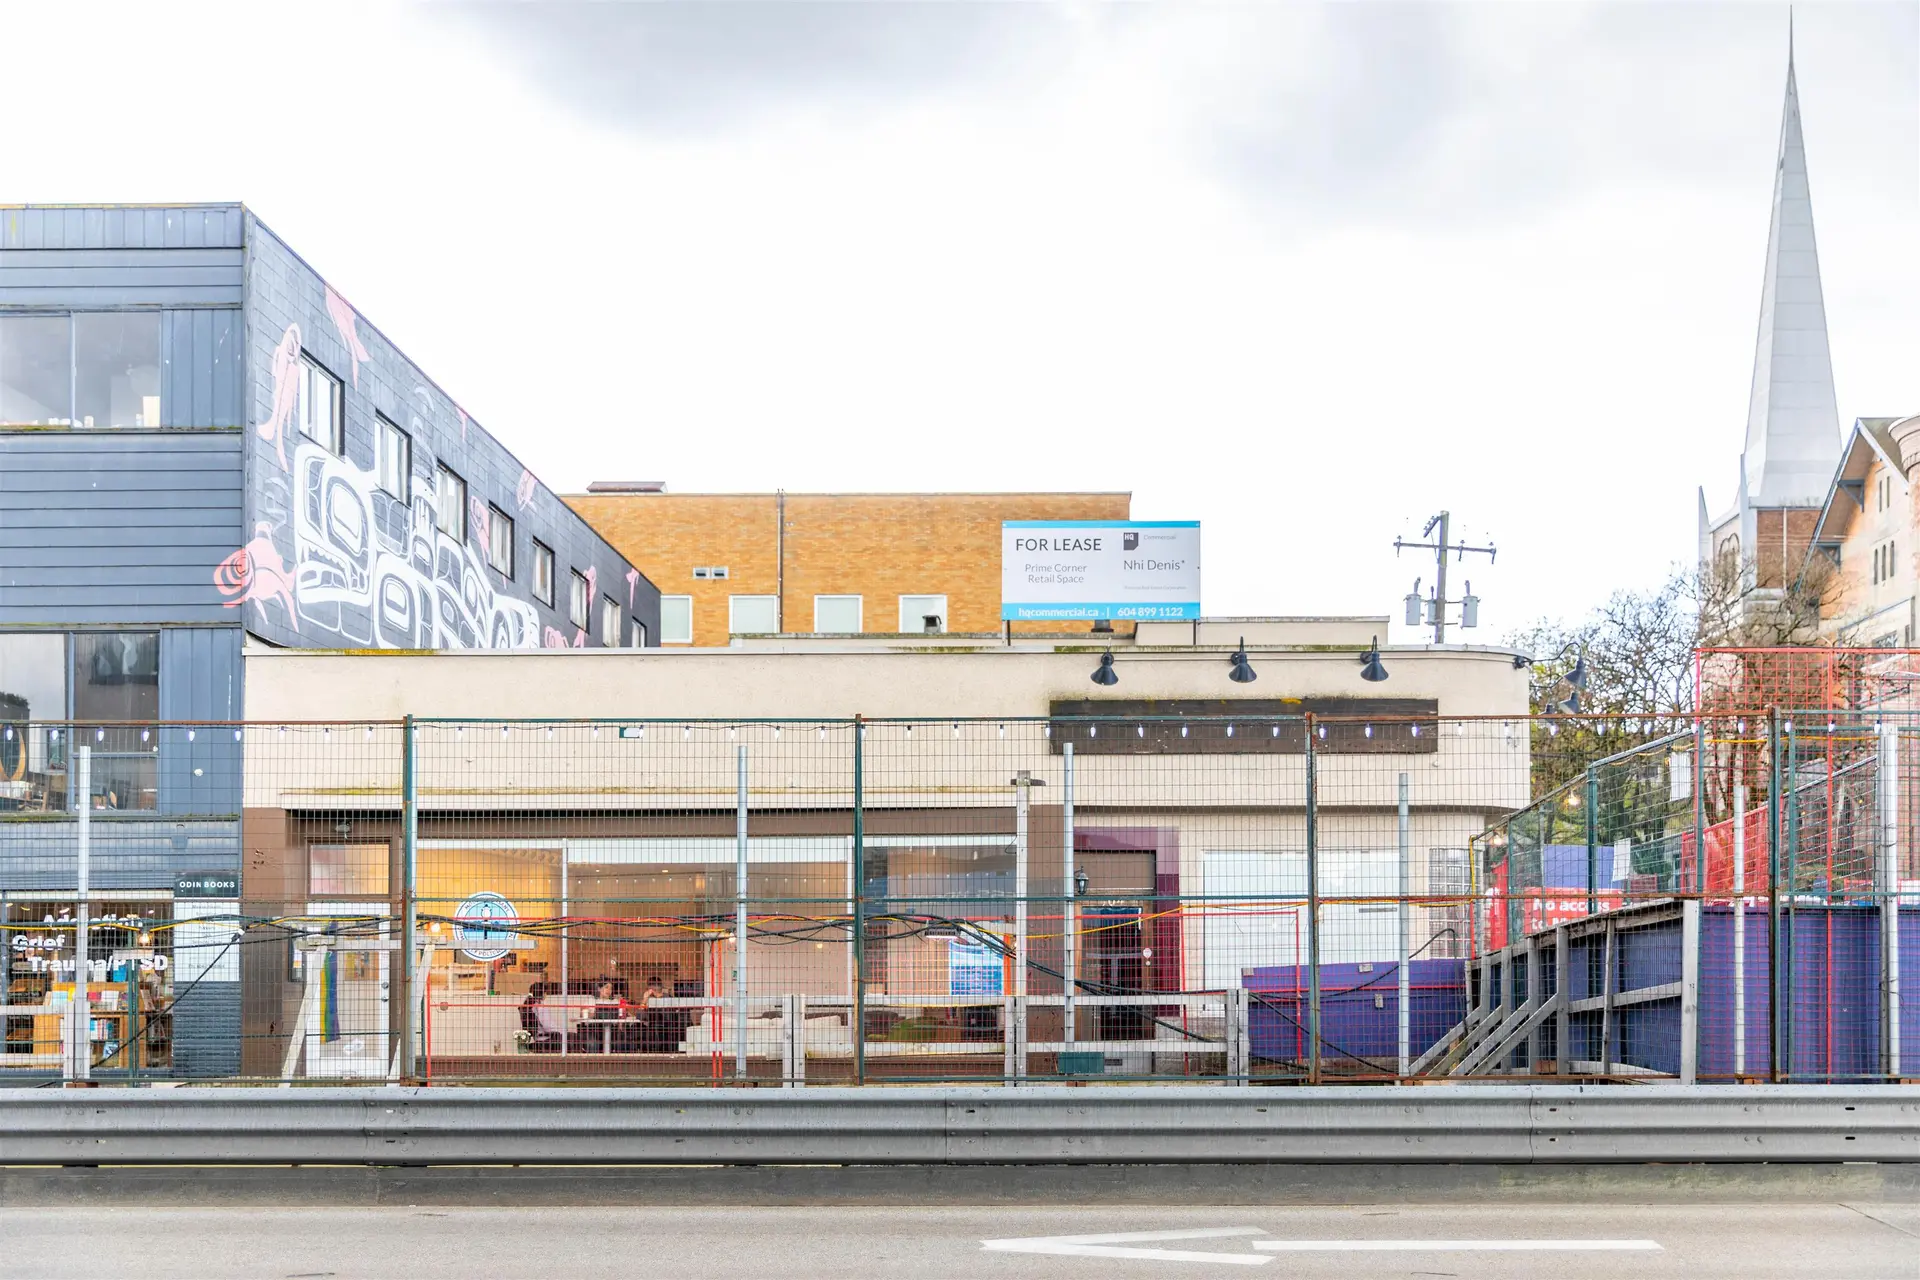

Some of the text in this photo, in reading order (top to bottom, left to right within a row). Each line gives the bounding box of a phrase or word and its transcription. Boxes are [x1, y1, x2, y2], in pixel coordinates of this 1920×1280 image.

[1124, 533, 1135, 541] HQ
[1016, 538, 1102, 551] FOR LEASE
[1025, 563, 1088, 573] Prime Corner
[1123, 559, 1144, 570] Nhi
[1028, 574, 1084, 584] Retail Space
[1018, 607, 1184, 618] hqcommercial.ca 604 899 1122
[179, 881, 236, 889] ODIN BOOKS
[12, 934, 66, 951] Grief
